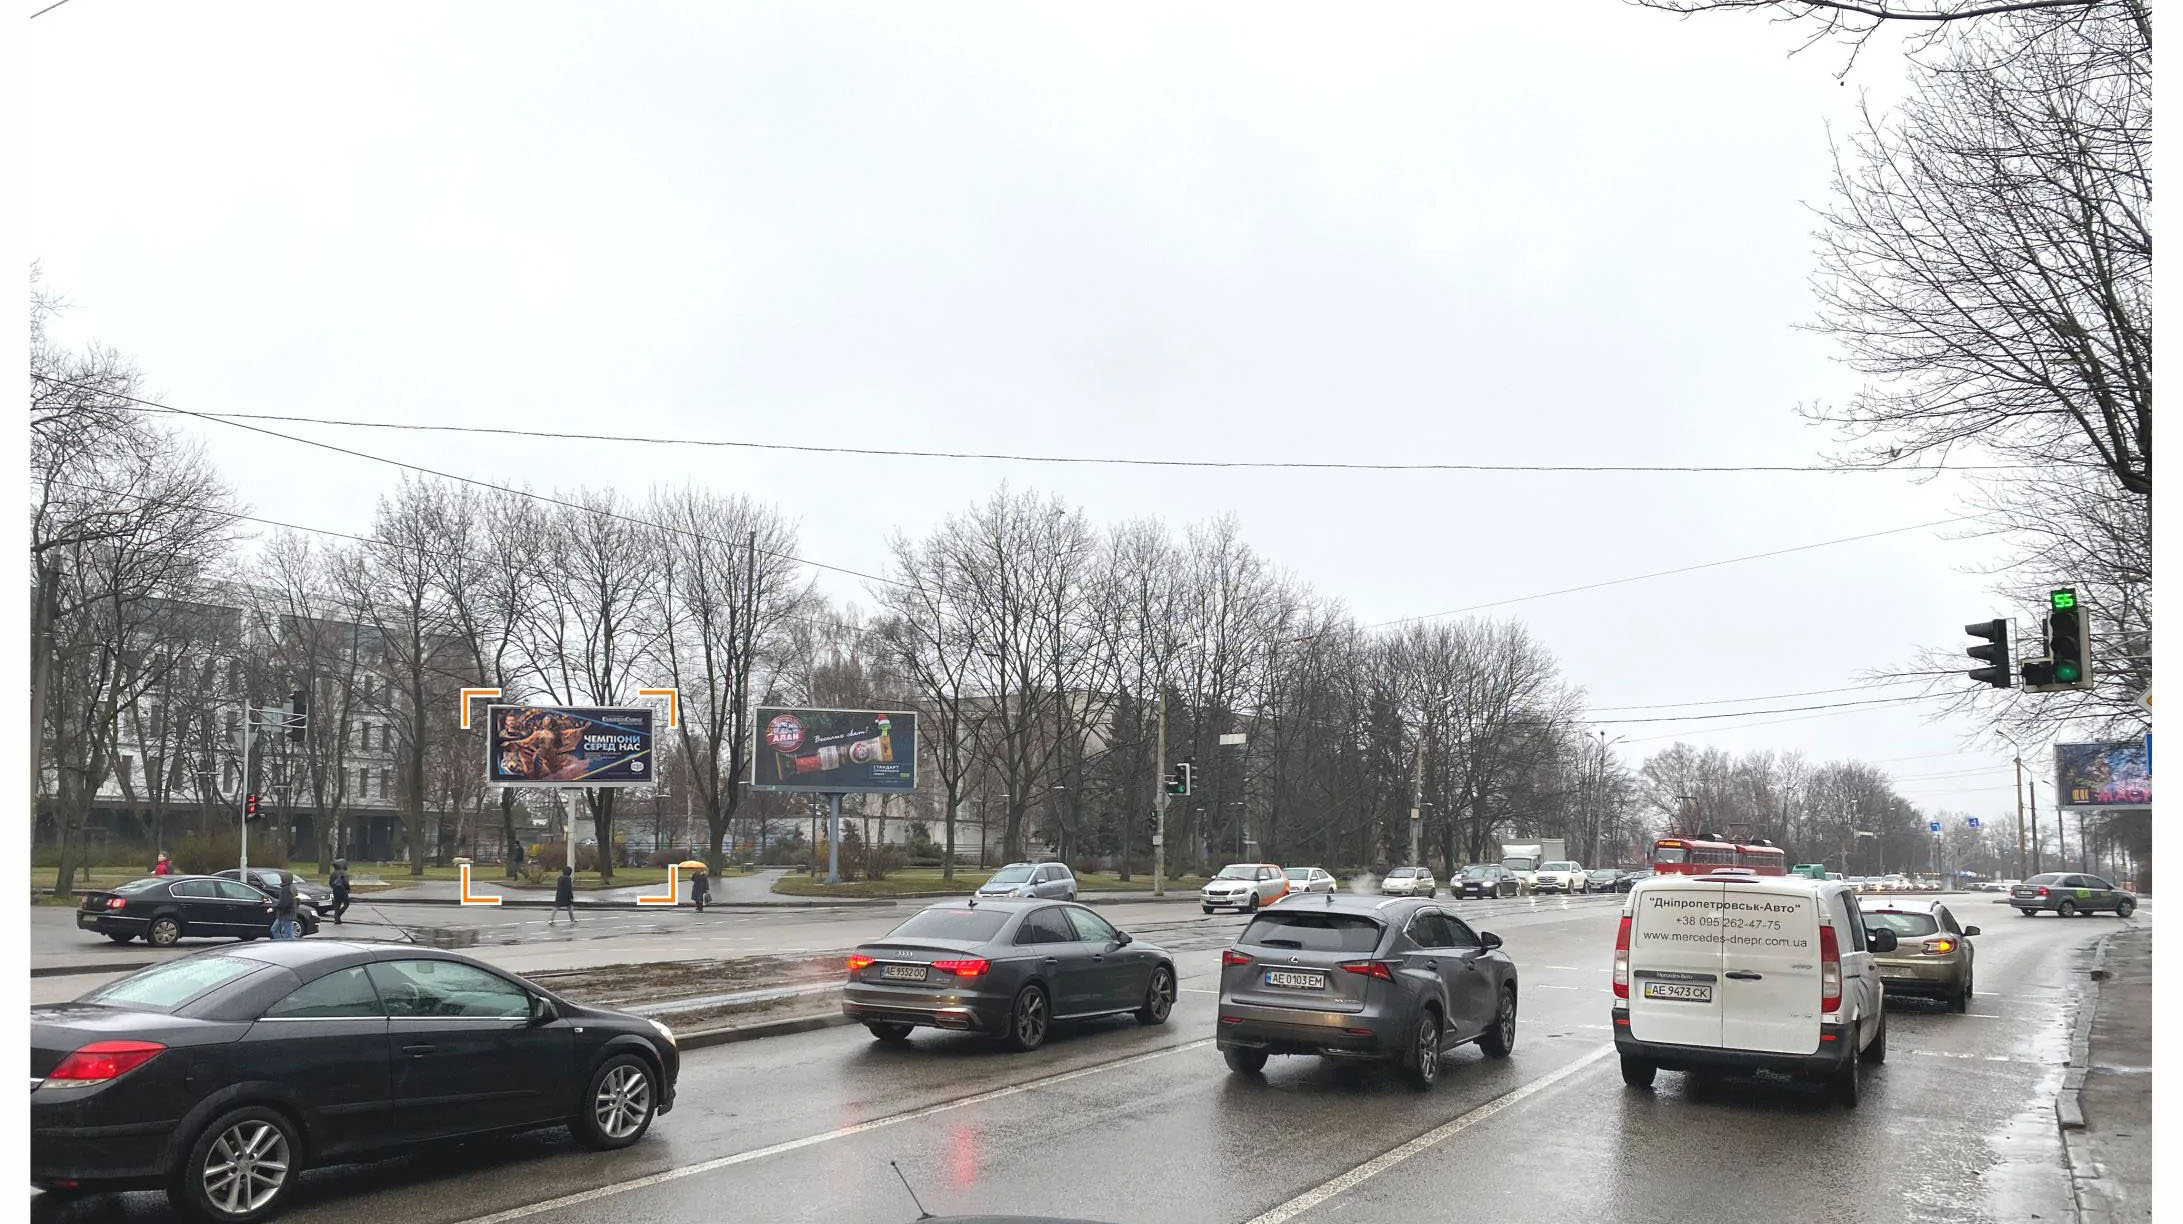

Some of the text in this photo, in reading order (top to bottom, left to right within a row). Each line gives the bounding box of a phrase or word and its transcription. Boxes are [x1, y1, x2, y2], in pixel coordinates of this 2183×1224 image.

[583, 735, 641, 743] ЧЕМПІОНИ
[772, 733, 799, 742] АЛАН
[583, 743, 640, 752] СЕРЕД НАС
[1649, 897, 1801, 914] "Дніпропетровськ-Авто"
[1675, 915, 1781, 931] +38 095 262-47-75
[1643, 931, 1808, 948] www.mercedes-dnepr.com.ua
[884, 966, 895, 976] AE
[896, 967, 913, 977] 9552
[1272, 974, 1322, 987] AE 0103 EM
[1652, 986, 1708, 998] AE 9473 CK
